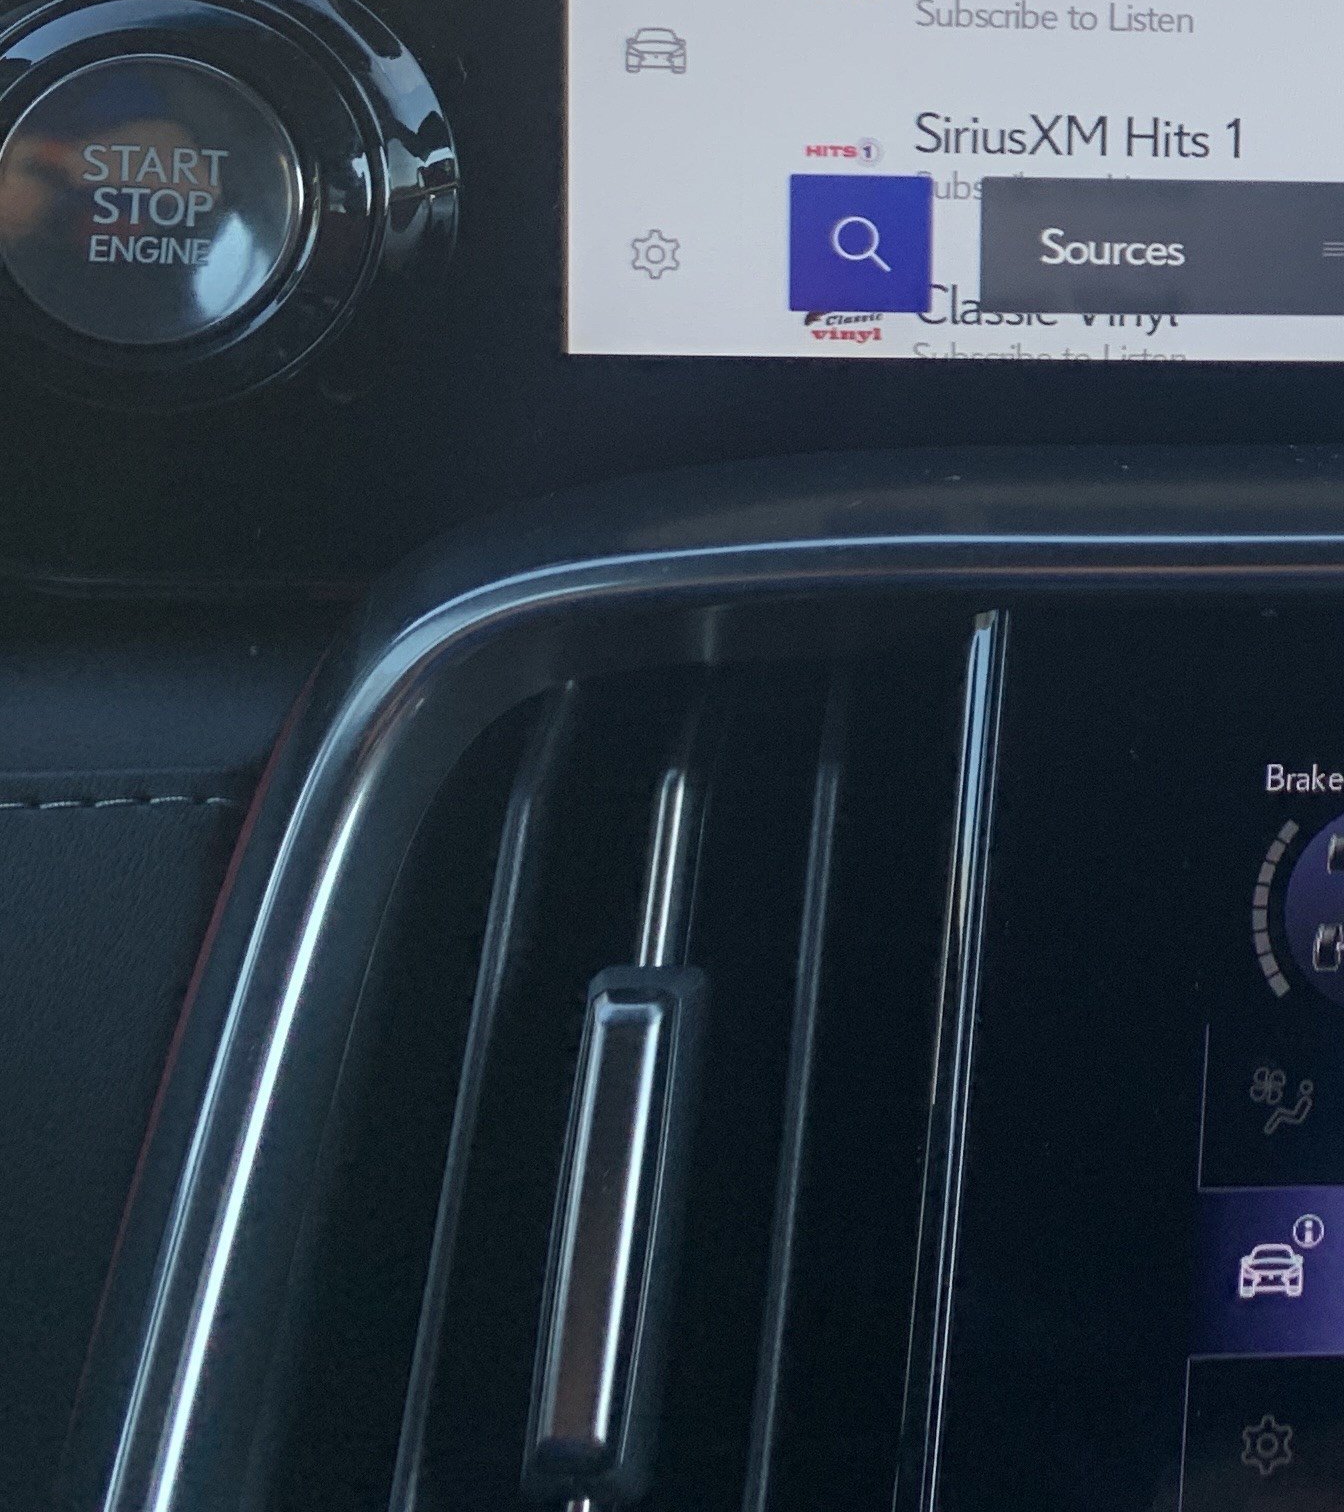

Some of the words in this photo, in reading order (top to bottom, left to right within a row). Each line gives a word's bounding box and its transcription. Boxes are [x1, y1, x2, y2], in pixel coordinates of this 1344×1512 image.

[1067, 6, 1098, 30] to
[1109, 3, 1193, 33] Listen
[805, 145, 857, 158] HITS
[915, 112, 1107, 156] SiriusXM
[1127, 117, 1209, 158] Hits
[1227, 118, 1240, 158] 1
[82, 145, 229, 187] START
[92, 187, 214, 228] STOP
[89, 233, 212, 266] ENGINE
[1041, 228, 1185, 265] Sources
[812, 328, 882, 344] vinyl
[1266, 764, 1344, 791] Brake
